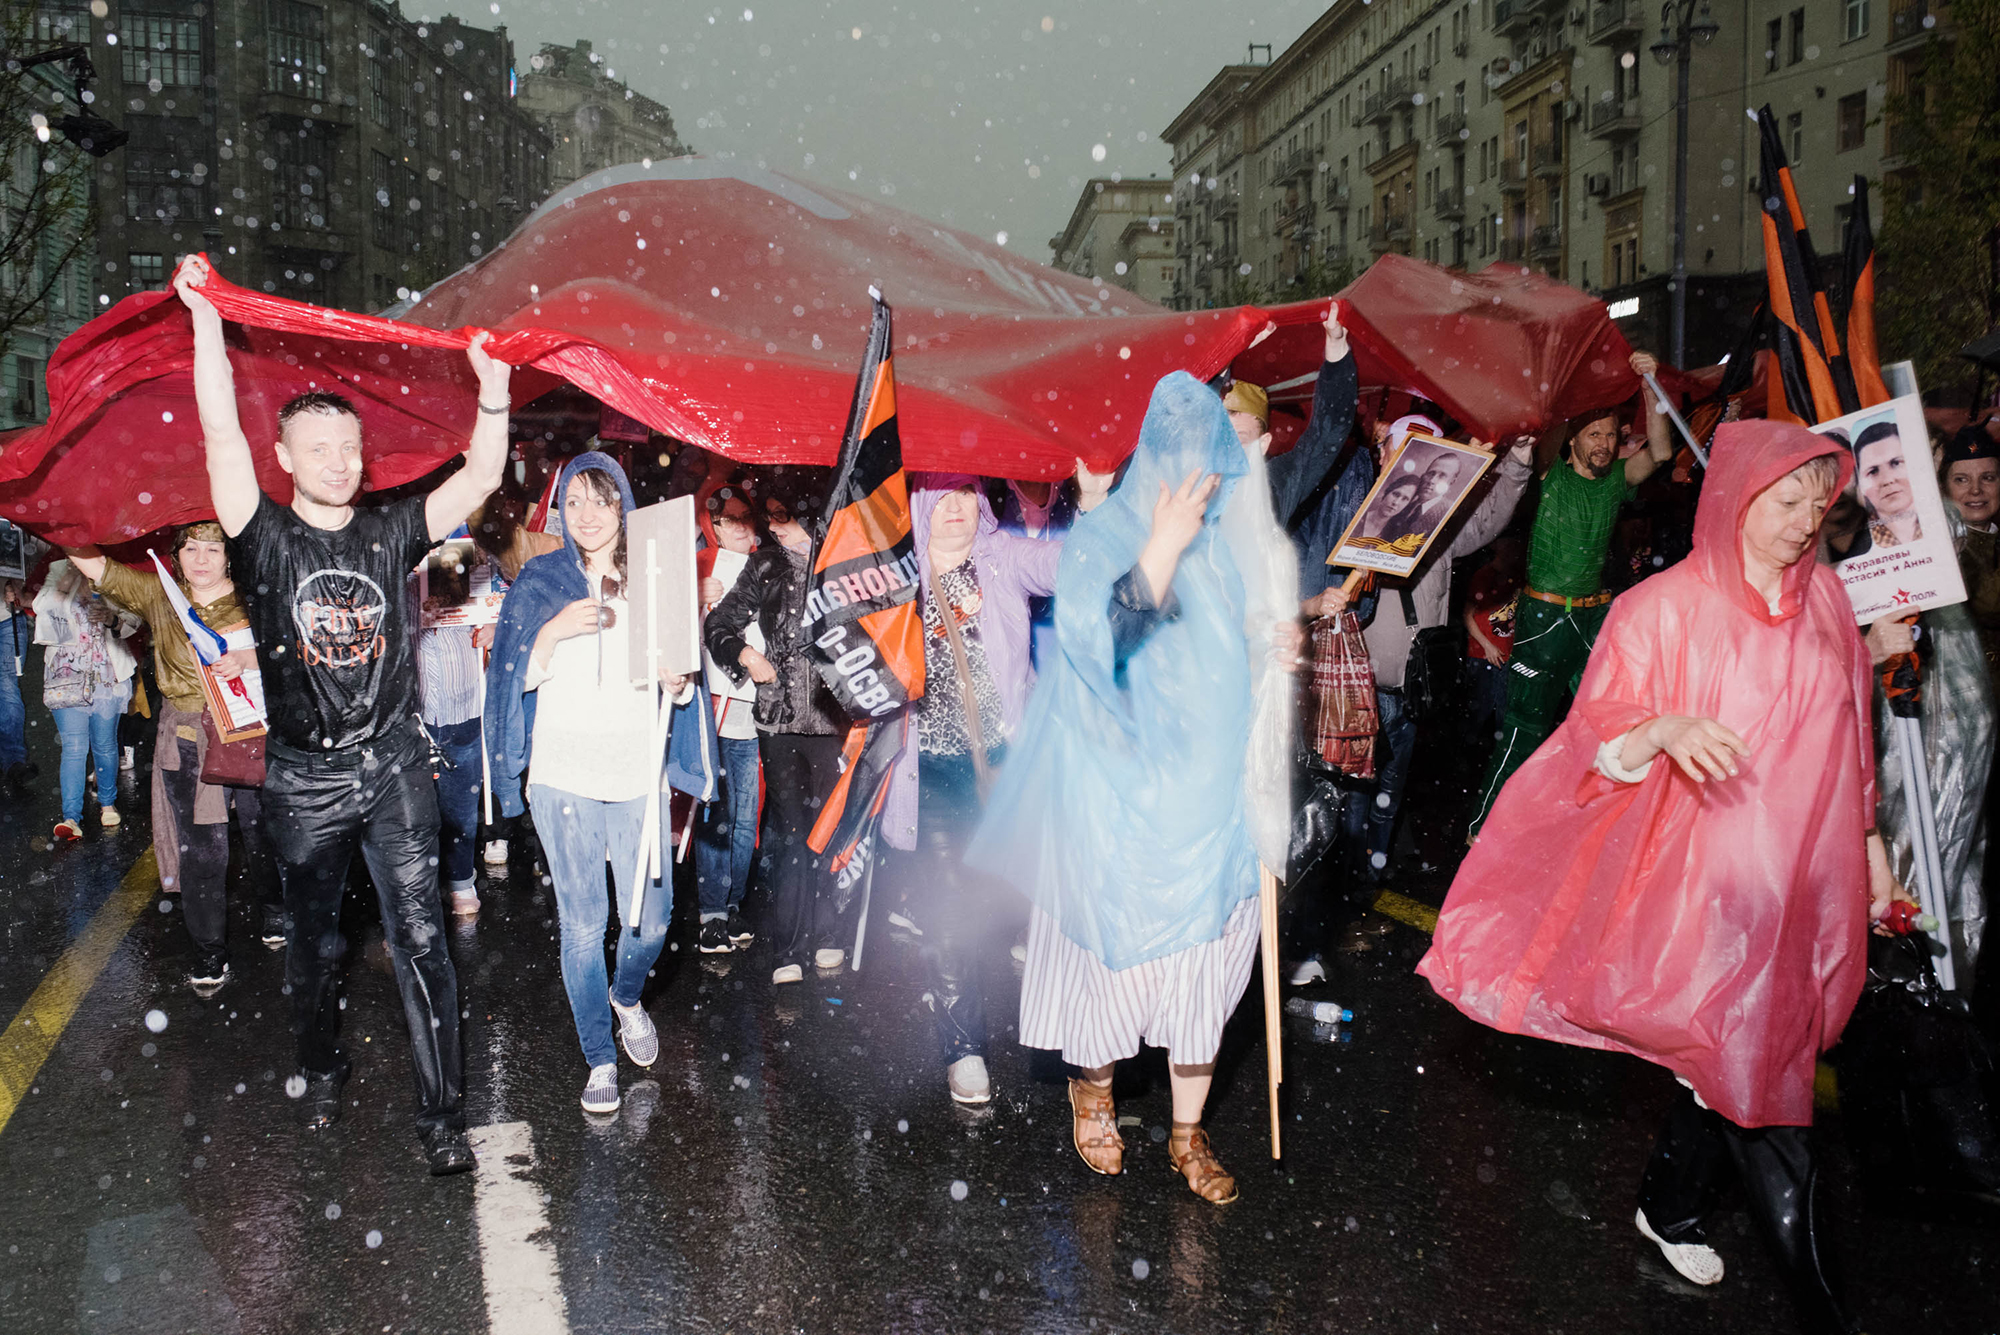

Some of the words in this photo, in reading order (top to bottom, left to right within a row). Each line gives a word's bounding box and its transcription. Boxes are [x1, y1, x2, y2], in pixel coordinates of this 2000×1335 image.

[1845, 550, 1911, 572] Журавлевы
[1892, 564, 1900, 572] и
[1903, 556, 1933, 570] Анна
[296, 635, 386, 669] SOUND
